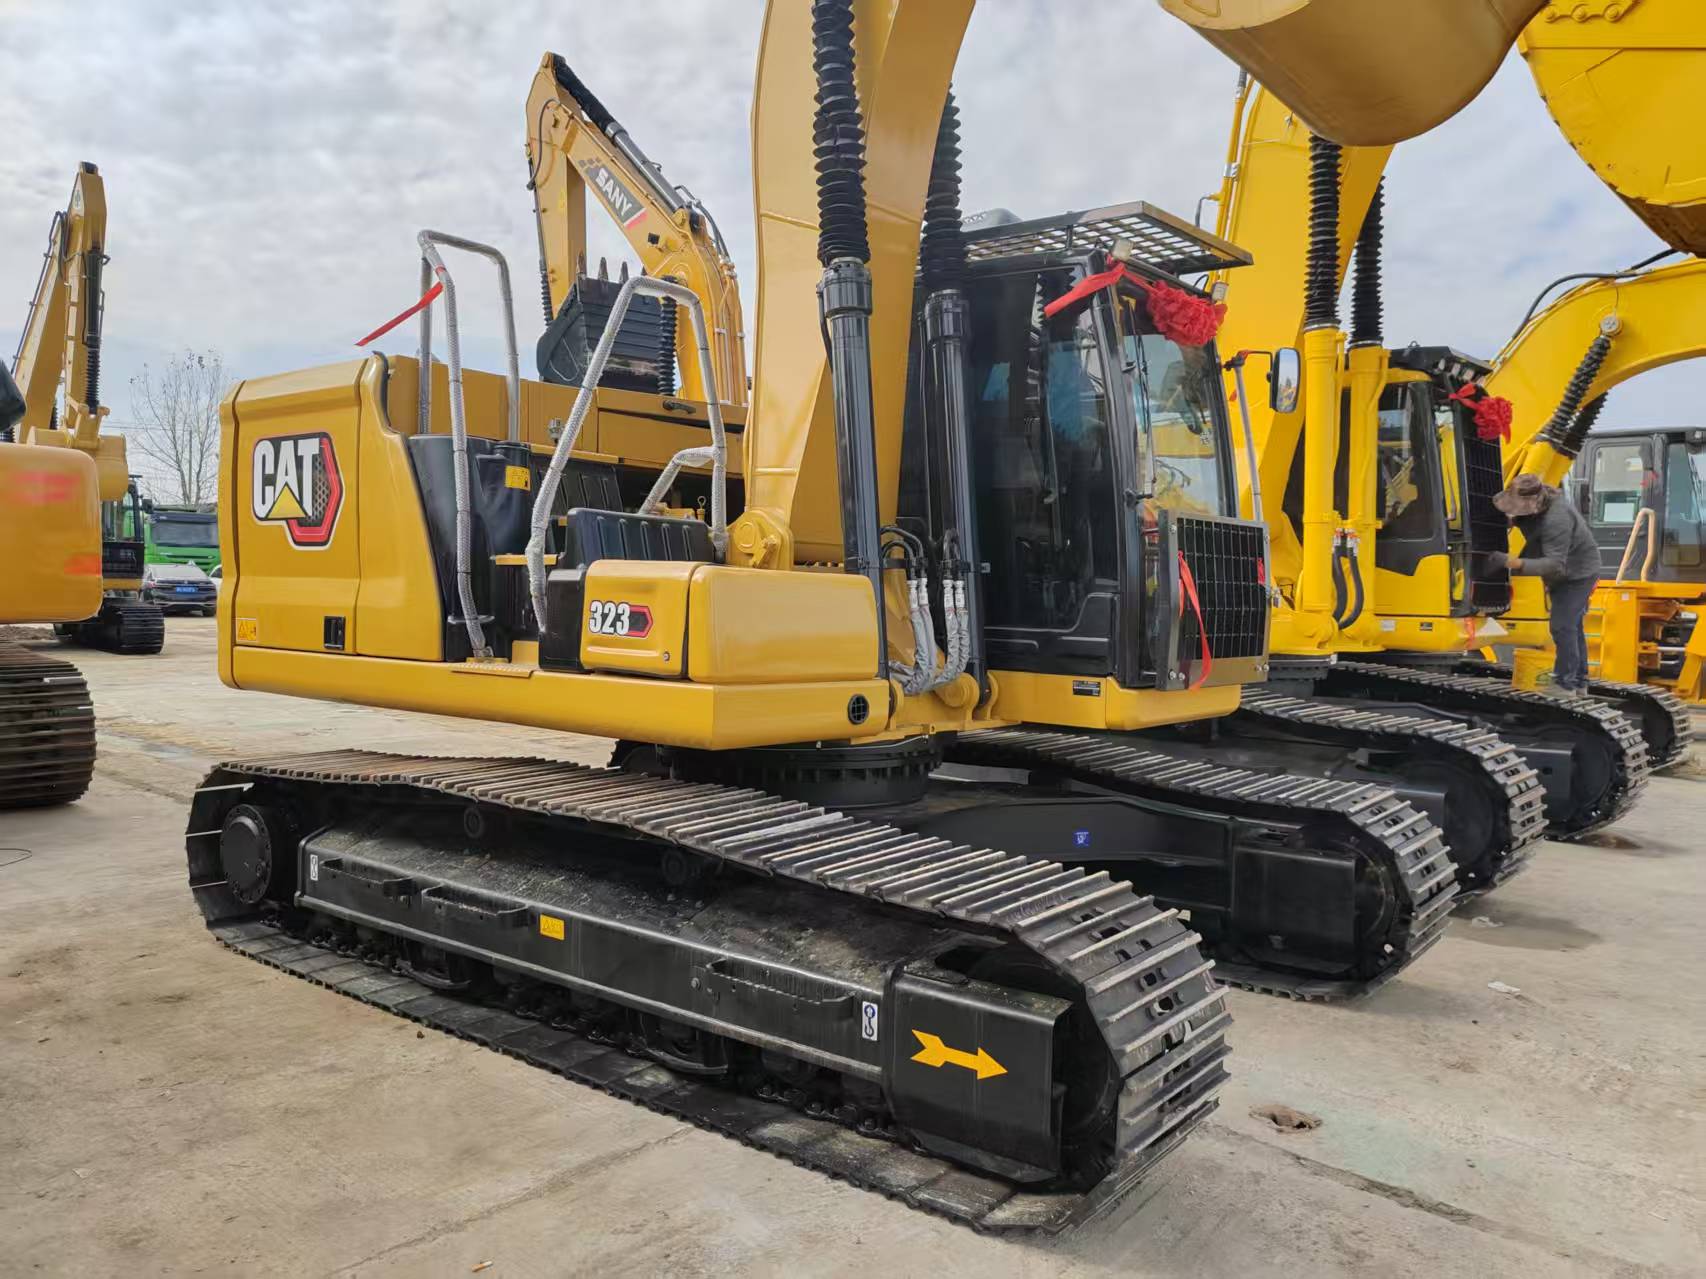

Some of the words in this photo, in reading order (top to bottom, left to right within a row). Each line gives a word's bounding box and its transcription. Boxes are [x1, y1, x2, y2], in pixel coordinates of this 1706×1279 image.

[595, 167, 633, 216] SANY
[252, 437, 320, 518] CAT
[588, 600, 631, 635] 323
